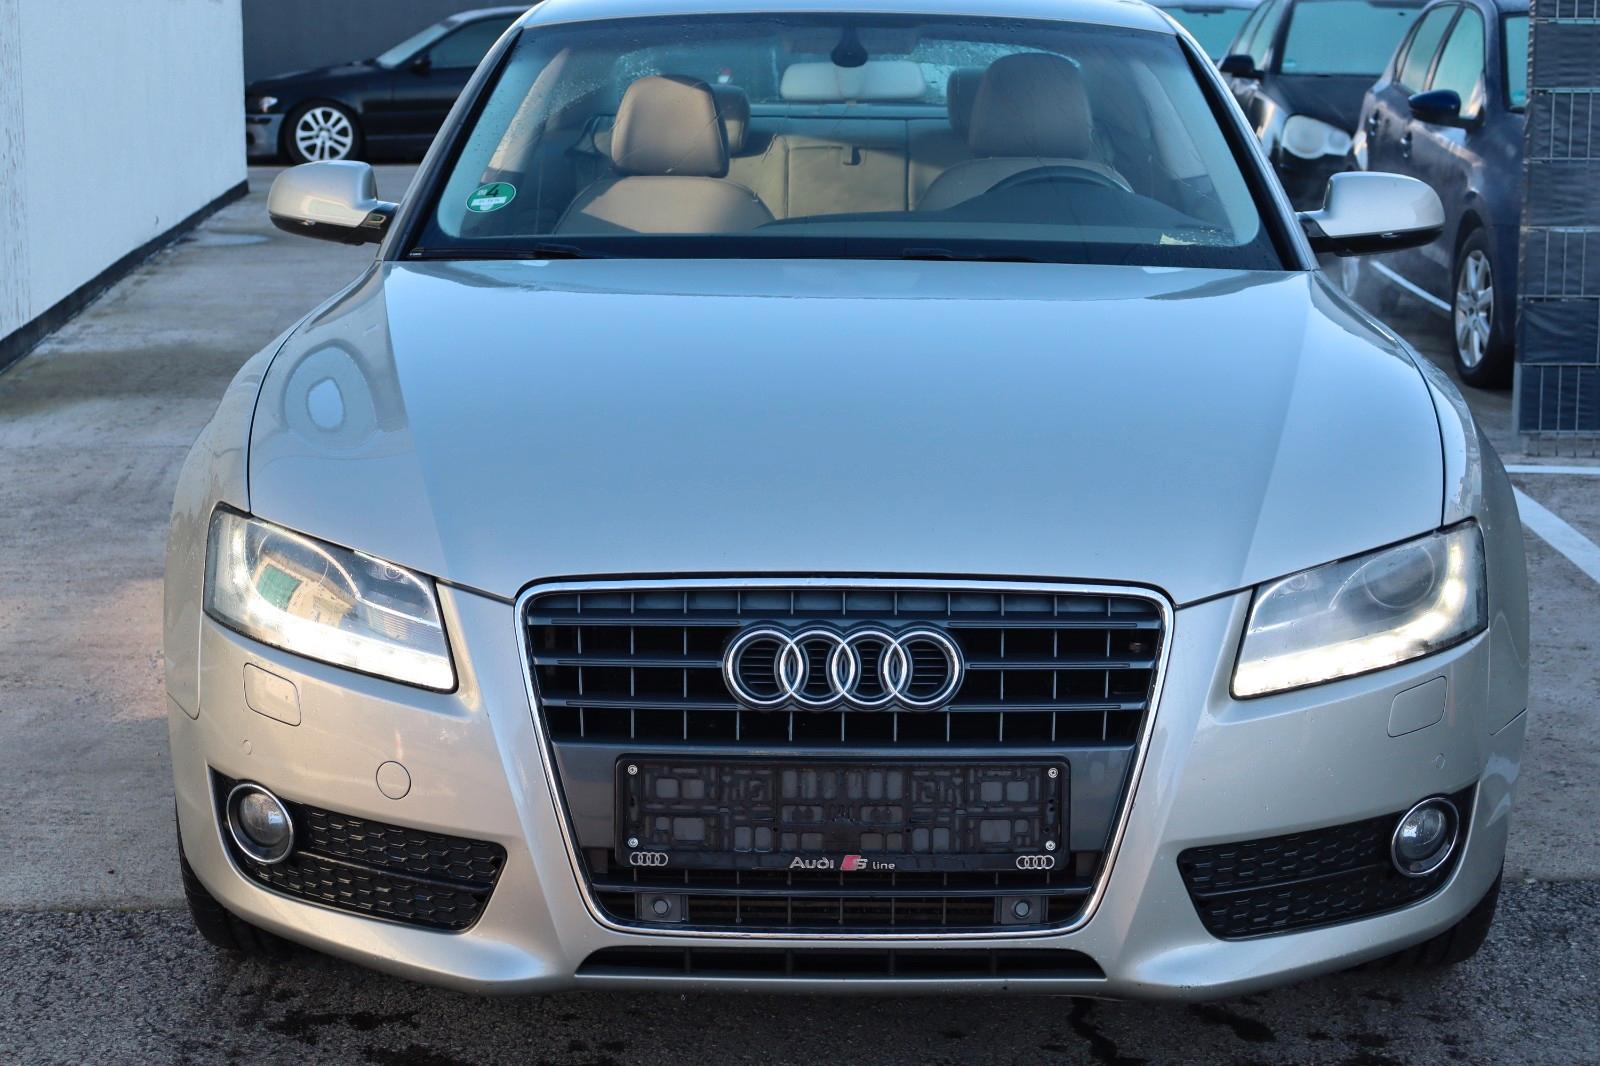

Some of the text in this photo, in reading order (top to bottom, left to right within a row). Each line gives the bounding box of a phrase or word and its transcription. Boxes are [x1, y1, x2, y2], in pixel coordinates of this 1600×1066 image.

[486, 184, 500, 197] 4
[789, 856, 834, 869] Audi
[872, 861, 896, 870] line
